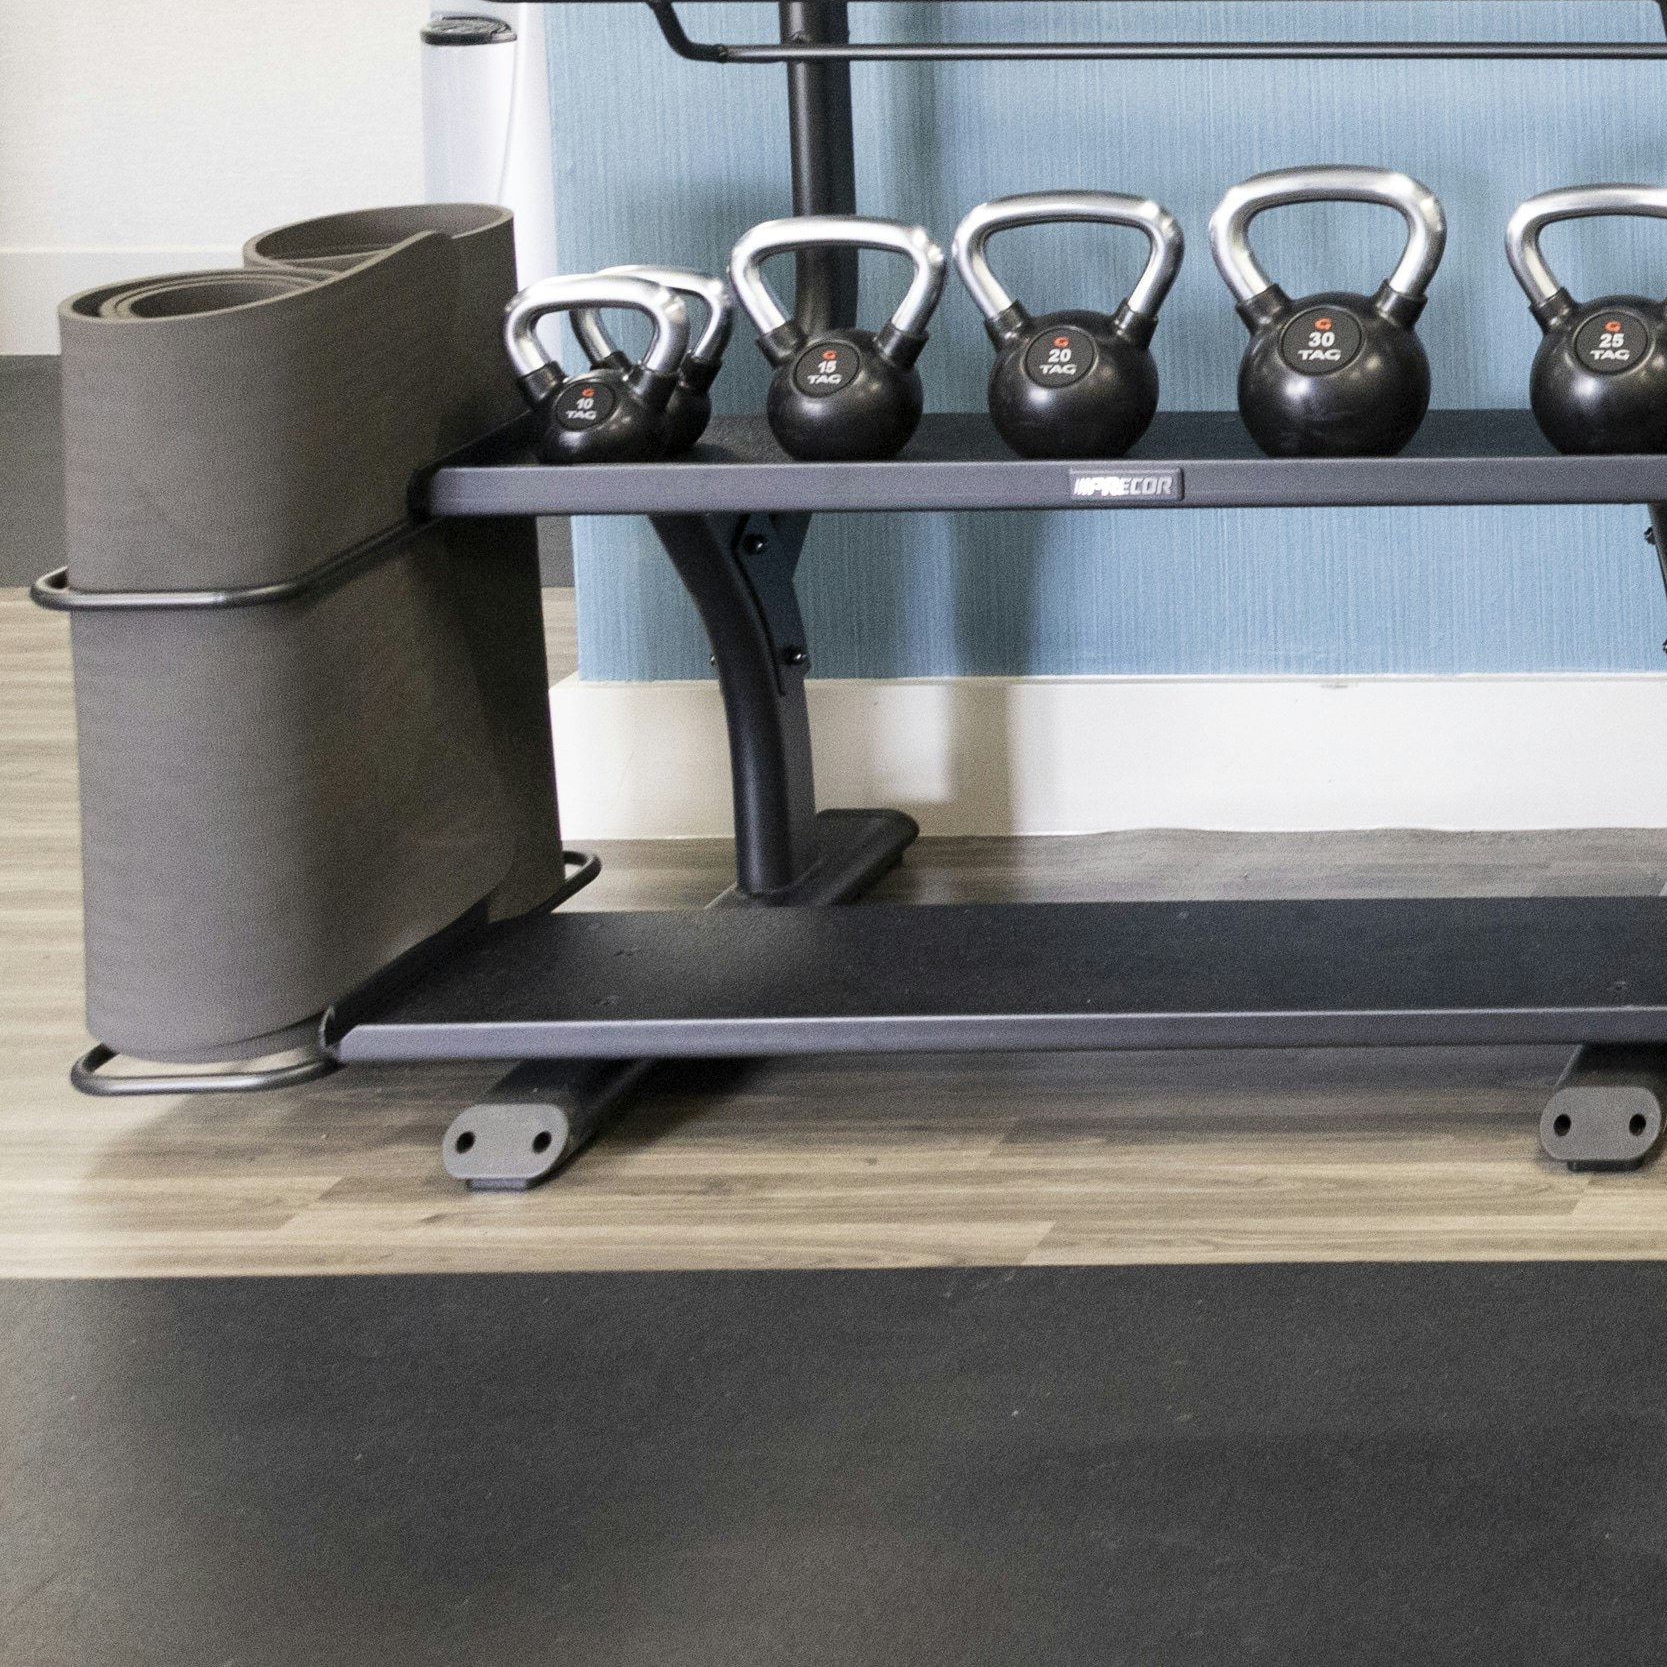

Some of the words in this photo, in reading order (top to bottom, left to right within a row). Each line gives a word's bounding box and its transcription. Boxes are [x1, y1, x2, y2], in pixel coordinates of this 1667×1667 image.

[1308, 331, 1335, 348] 30
[1599, 333, 1624, 348] 25
[1048, 348, 1072, 363] 20
[1298, 349, 1341, 361] TAG
[1590, 349, 1630, 361] TAG
[818, 360, 837, 374] 15
[1039, 364, 1077, 375] TAG
[807, 374, 842, 384] TAG
[576, 397, 594, 410] 10
[565, 410, 597, 420] TAG
[1086, 476, 1173, 497] PRECOR
